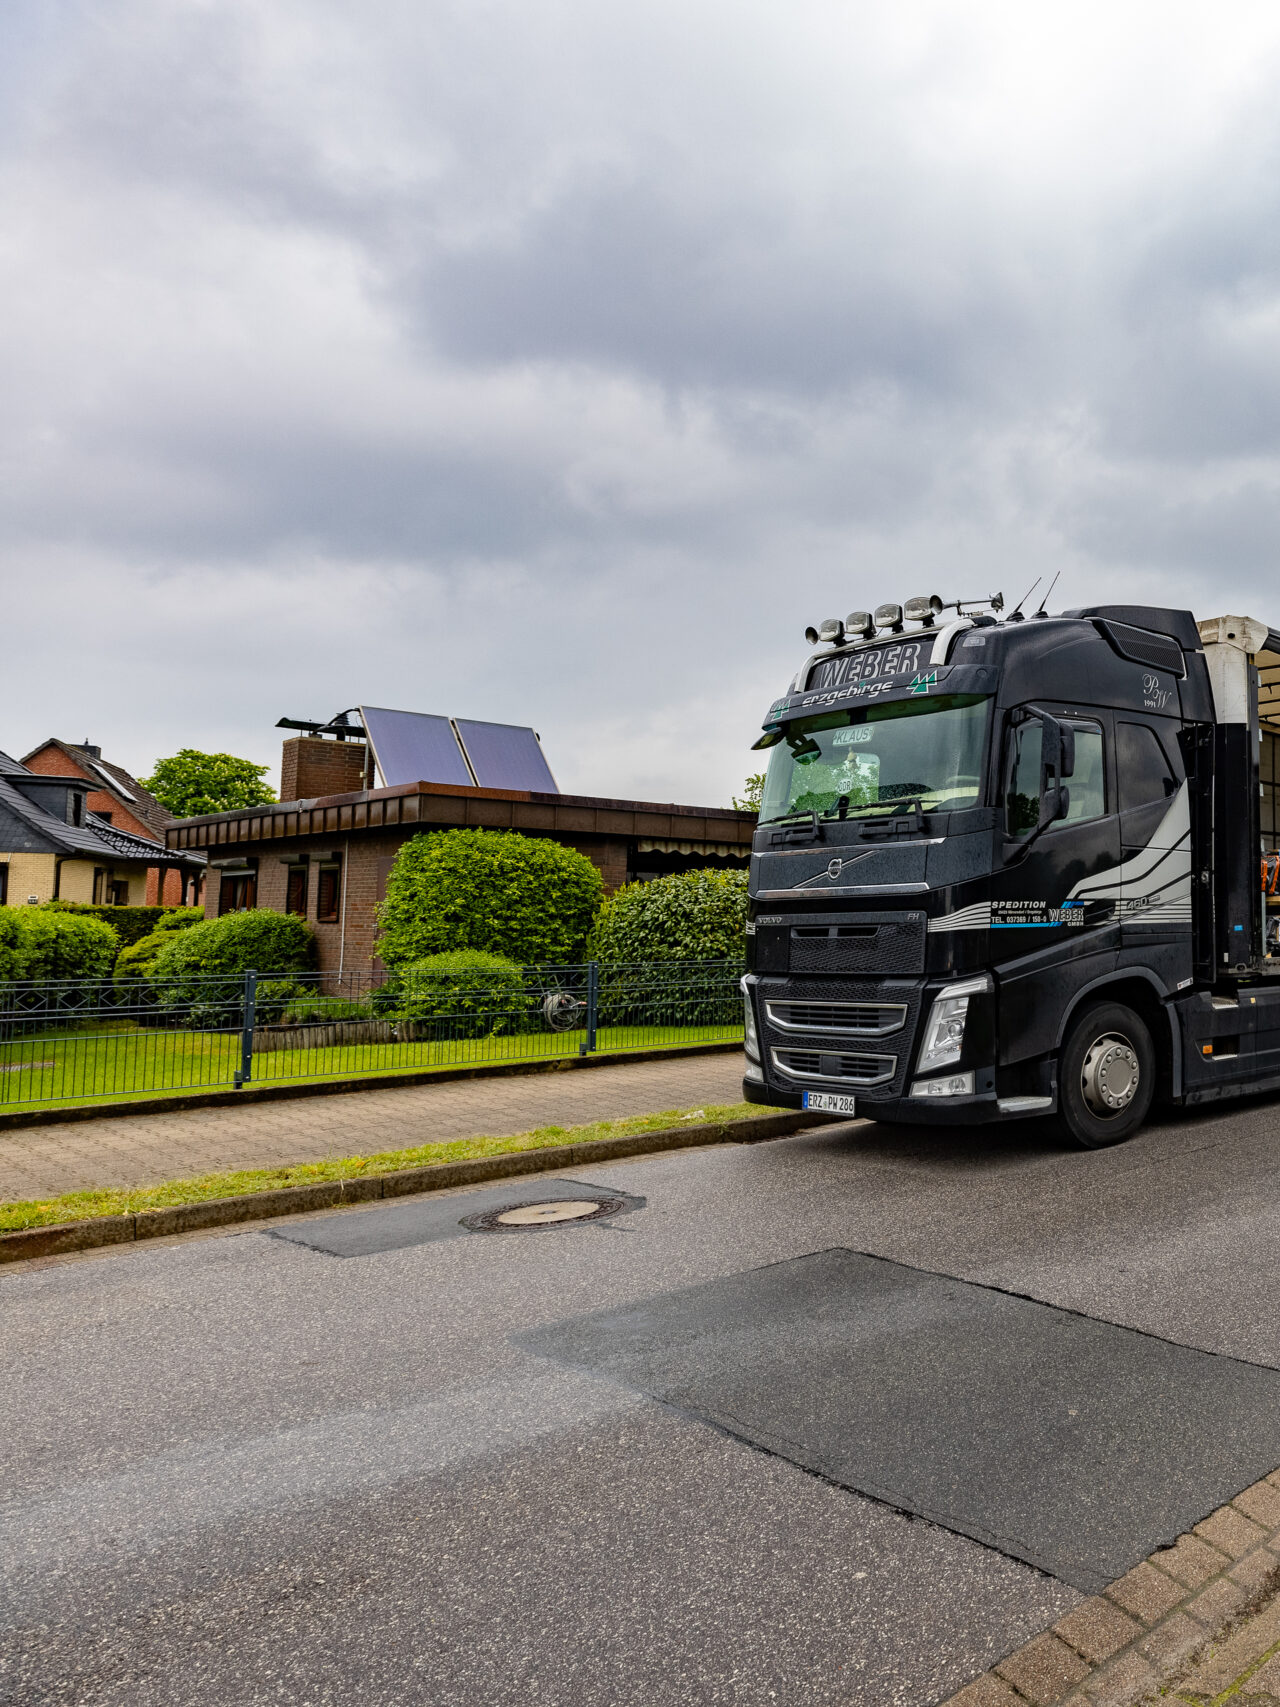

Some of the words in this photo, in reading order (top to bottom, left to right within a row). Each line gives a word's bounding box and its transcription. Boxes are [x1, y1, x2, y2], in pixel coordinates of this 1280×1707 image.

[819, 643, 921, 690] WEBER
[1143, 699, 1156, 708] 1991
[835, 727, 870, 744] KLAUS
[991, 900, 1047, 909] SPEDITION
[1126, 896, 1148, 911] 460
[907, 912, 920, 921] FH
[991, 916, 1005, 924] TEL.
[1048, 907, 1084, 922] WEBER
[808, 1093, 823, 1108] ERZ
[828, 1095, 838, 1110] PW
[839, 1097, 854, 1112] 286
